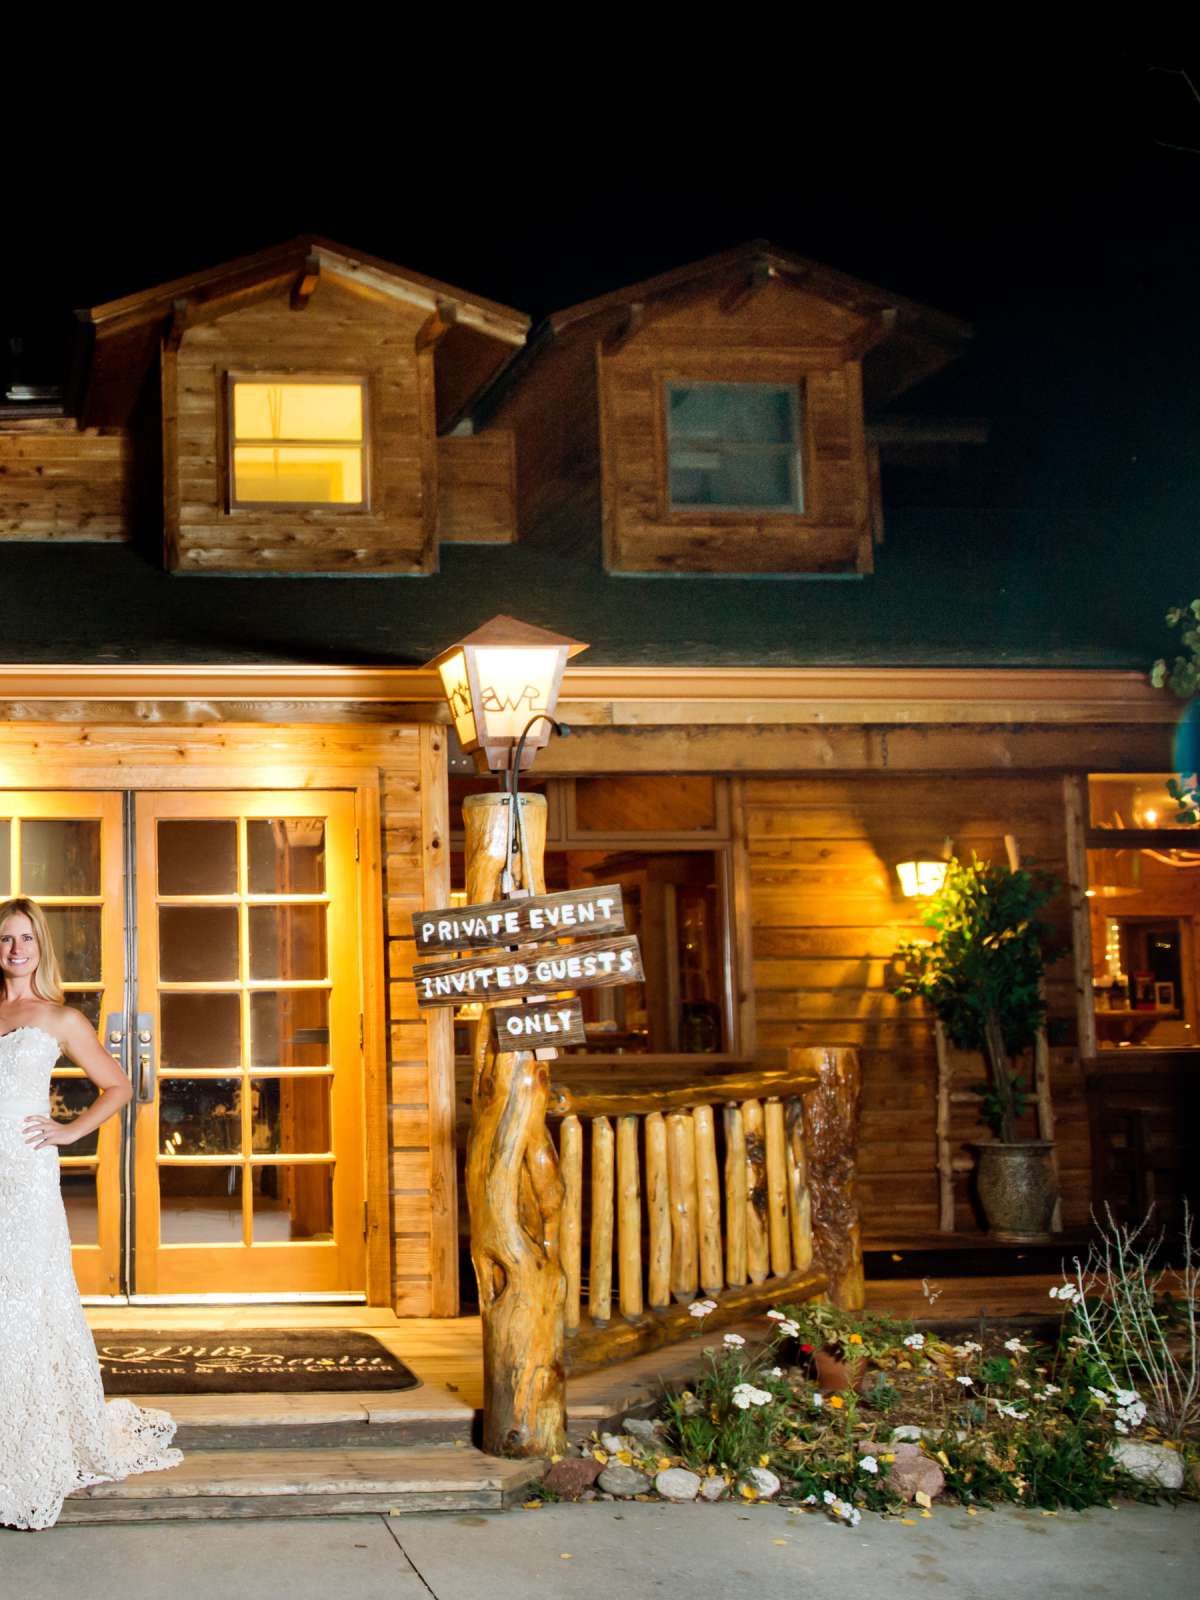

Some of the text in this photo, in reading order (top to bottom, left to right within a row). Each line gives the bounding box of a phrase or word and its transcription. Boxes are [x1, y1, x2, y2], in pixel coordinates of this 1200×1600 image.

[422, 898, 614, 943] PRIVATE EVENT
[422, 951, 633, 998] INVITED GUESTS
[506, 1010, 572, 1036] ONLY
